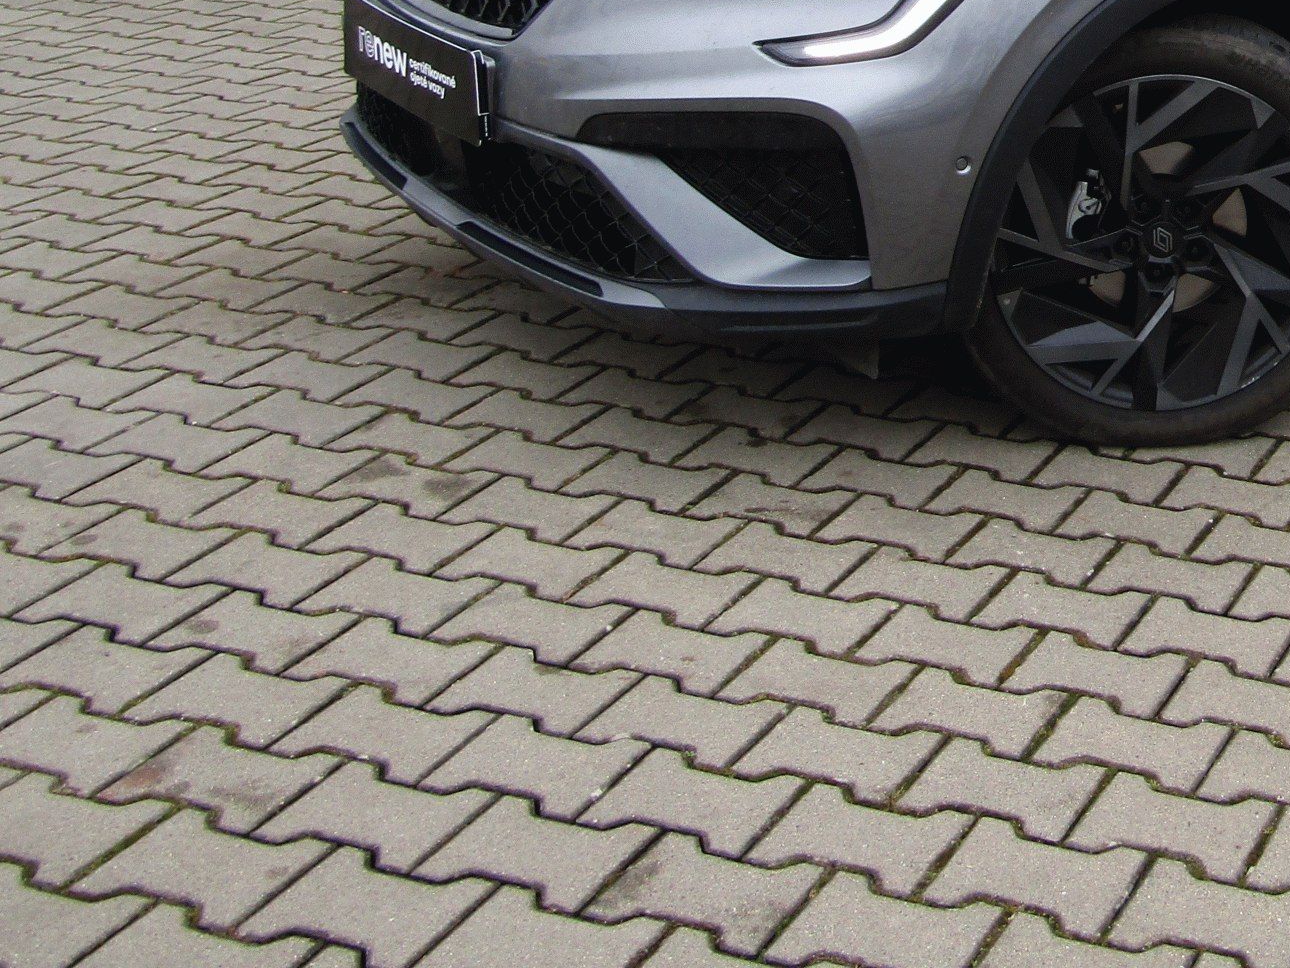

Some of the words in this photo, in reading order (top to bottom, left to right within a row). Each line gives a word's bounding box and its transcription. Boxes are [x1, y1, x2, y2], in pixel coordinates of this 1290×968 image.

[358, 26, 408, 77] renew
[409, 58, 457, 89] certifikované
[428, 80, 446, 99] vozy
